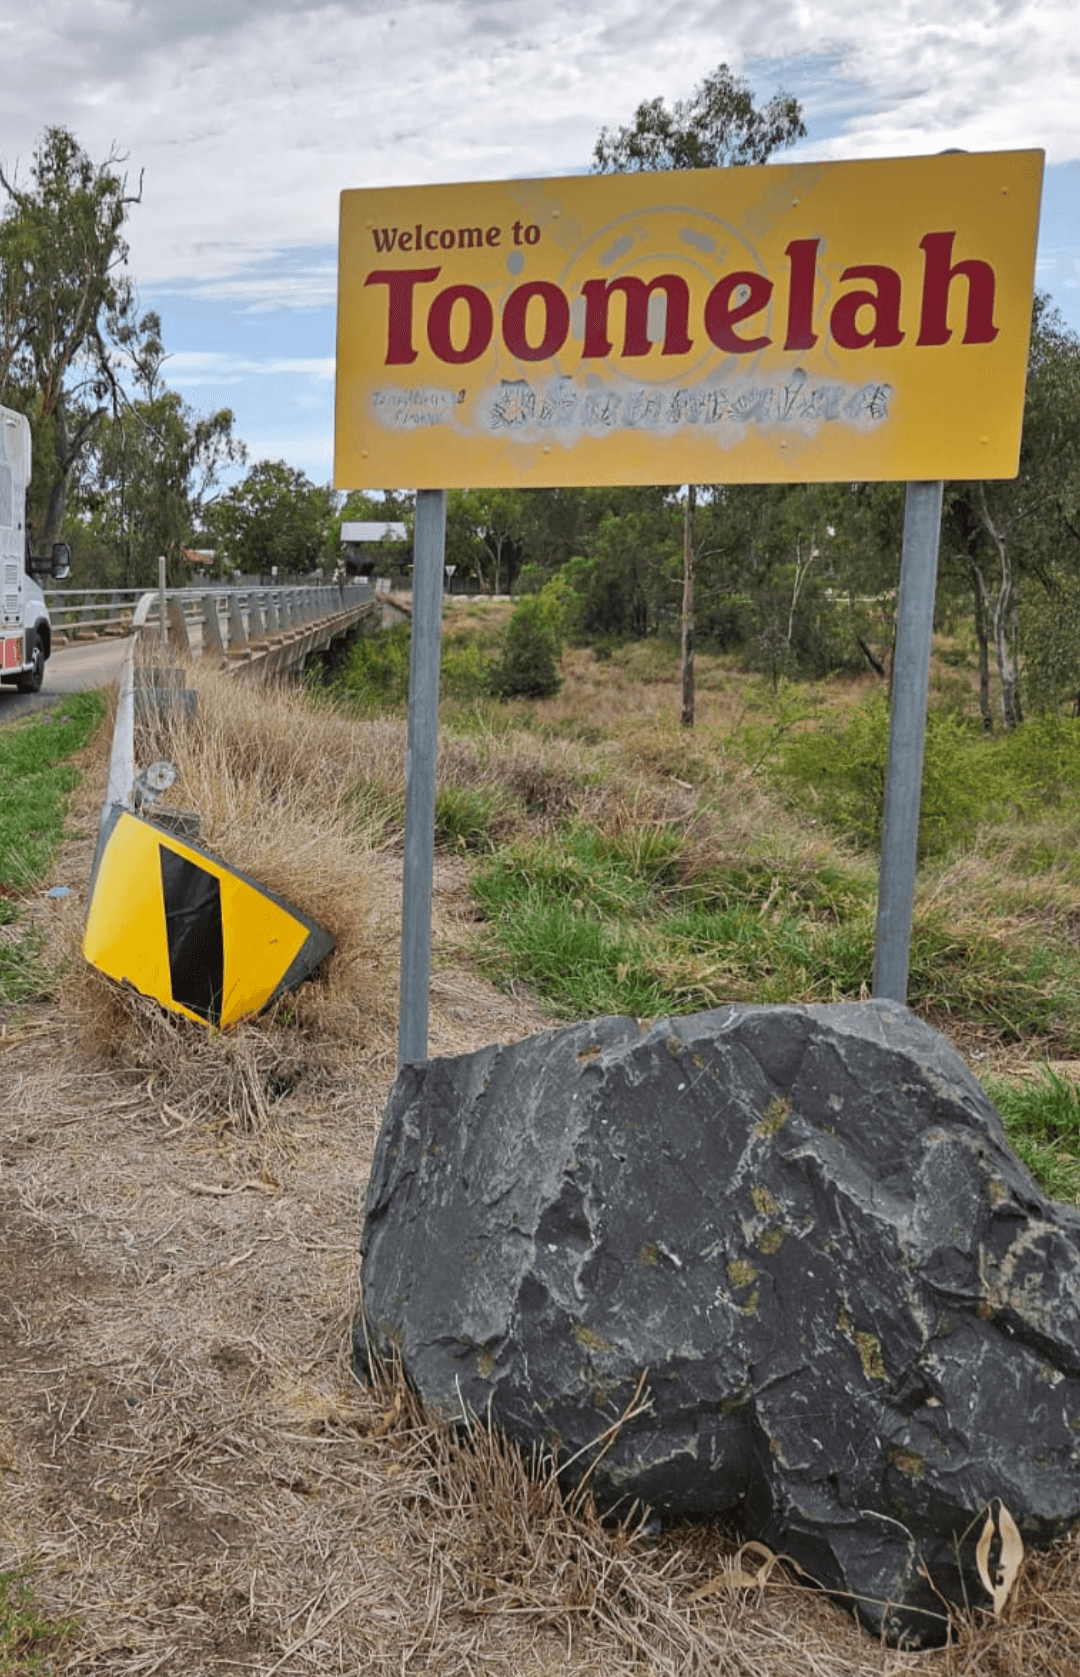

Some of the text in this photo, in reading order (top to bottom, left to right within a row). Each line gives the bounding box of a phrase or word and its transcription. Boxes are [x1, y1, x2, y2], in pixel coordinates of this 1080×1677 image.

[372, 221, 541, 252] Welcome to
[364, 231, 999, 366] Toomelah
